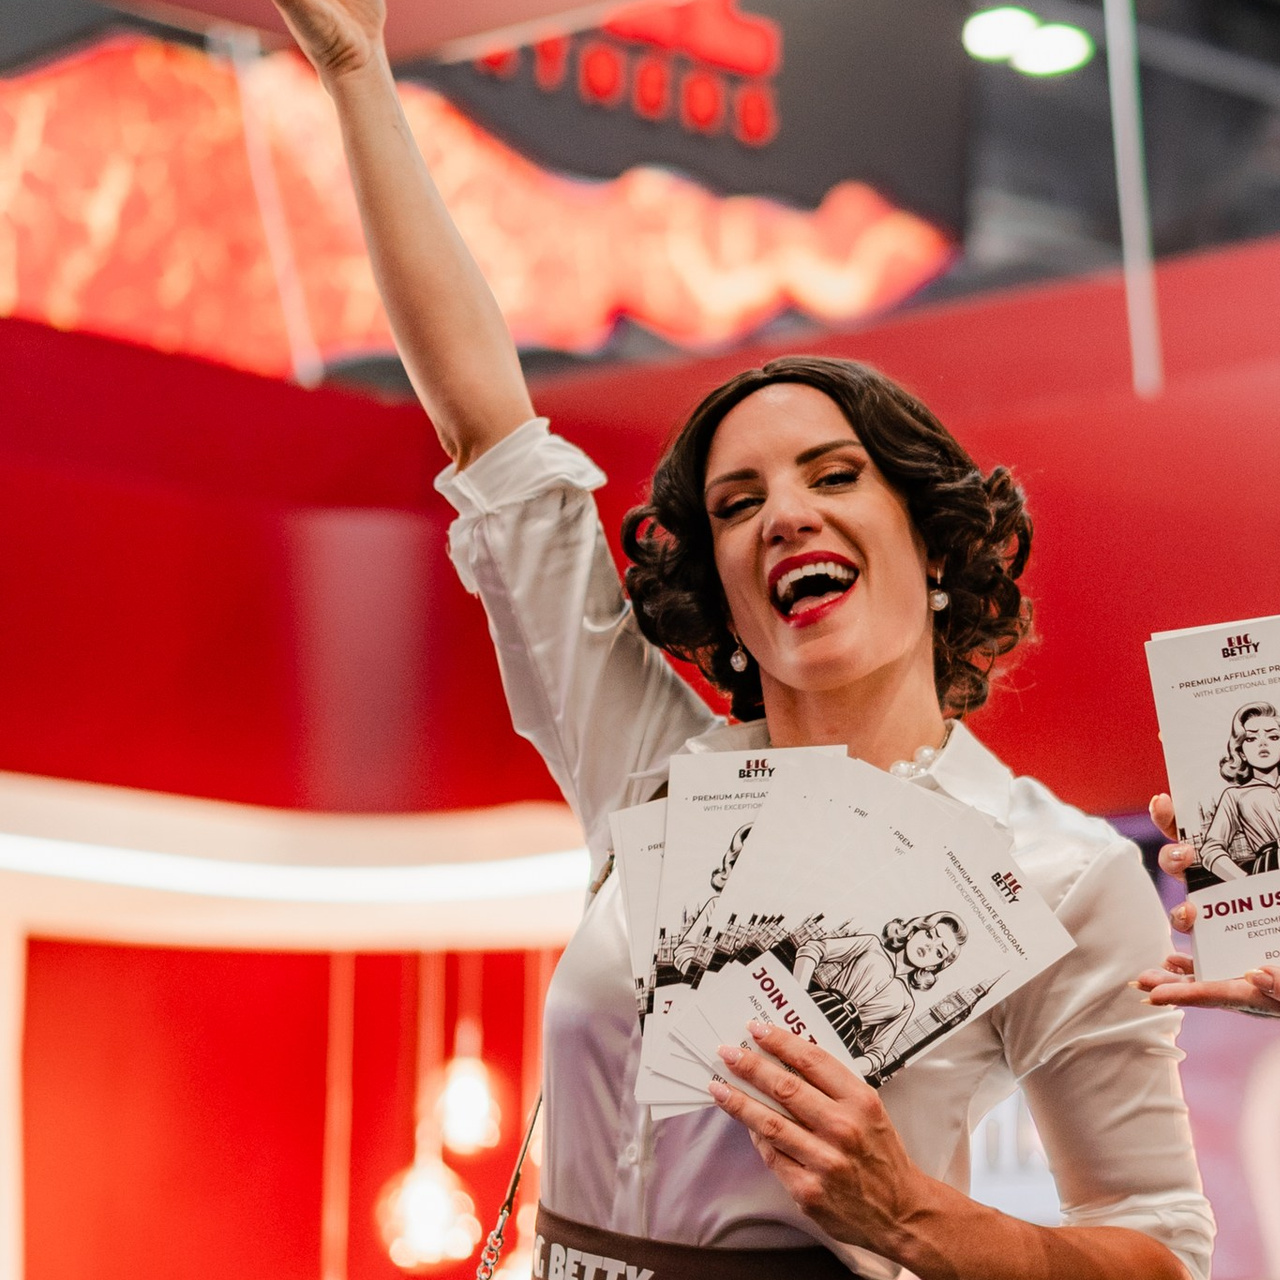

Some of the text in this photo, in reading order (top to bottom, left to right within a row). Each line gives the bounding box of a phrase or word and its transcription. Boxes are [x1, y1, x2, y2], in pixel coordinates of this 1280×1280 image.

[1221, 642, 1260, 658] BETTY
[1179, 676, 1221, 689] PREMIUM
[1223, 667, 1266, 681] AFFILIATE
[1193, 689, 1213, 698] WITH
[1215, 680, 1266, 695] EXCEPTIONAL
[739, 768, 775, 778] BETTY
[692, 794, 732, 802] PREMIUM
[703, 804, 723, 812] WITH
[991, 872, 1020, 904] BETTY
[946, 851, 973, 885] PREMIUM
[971, 885, 999, 920] AFFILIATE
[996, 919, 1025, 956] PROGRAM
[1202, 896, 1254, 920] JOIN
[1224, 922, 1244, 933] AND
[748, 995, 762, 1012] AND
[752, 966, 788, 1011] JOIN
[784, 1009, 807, 1036] US
